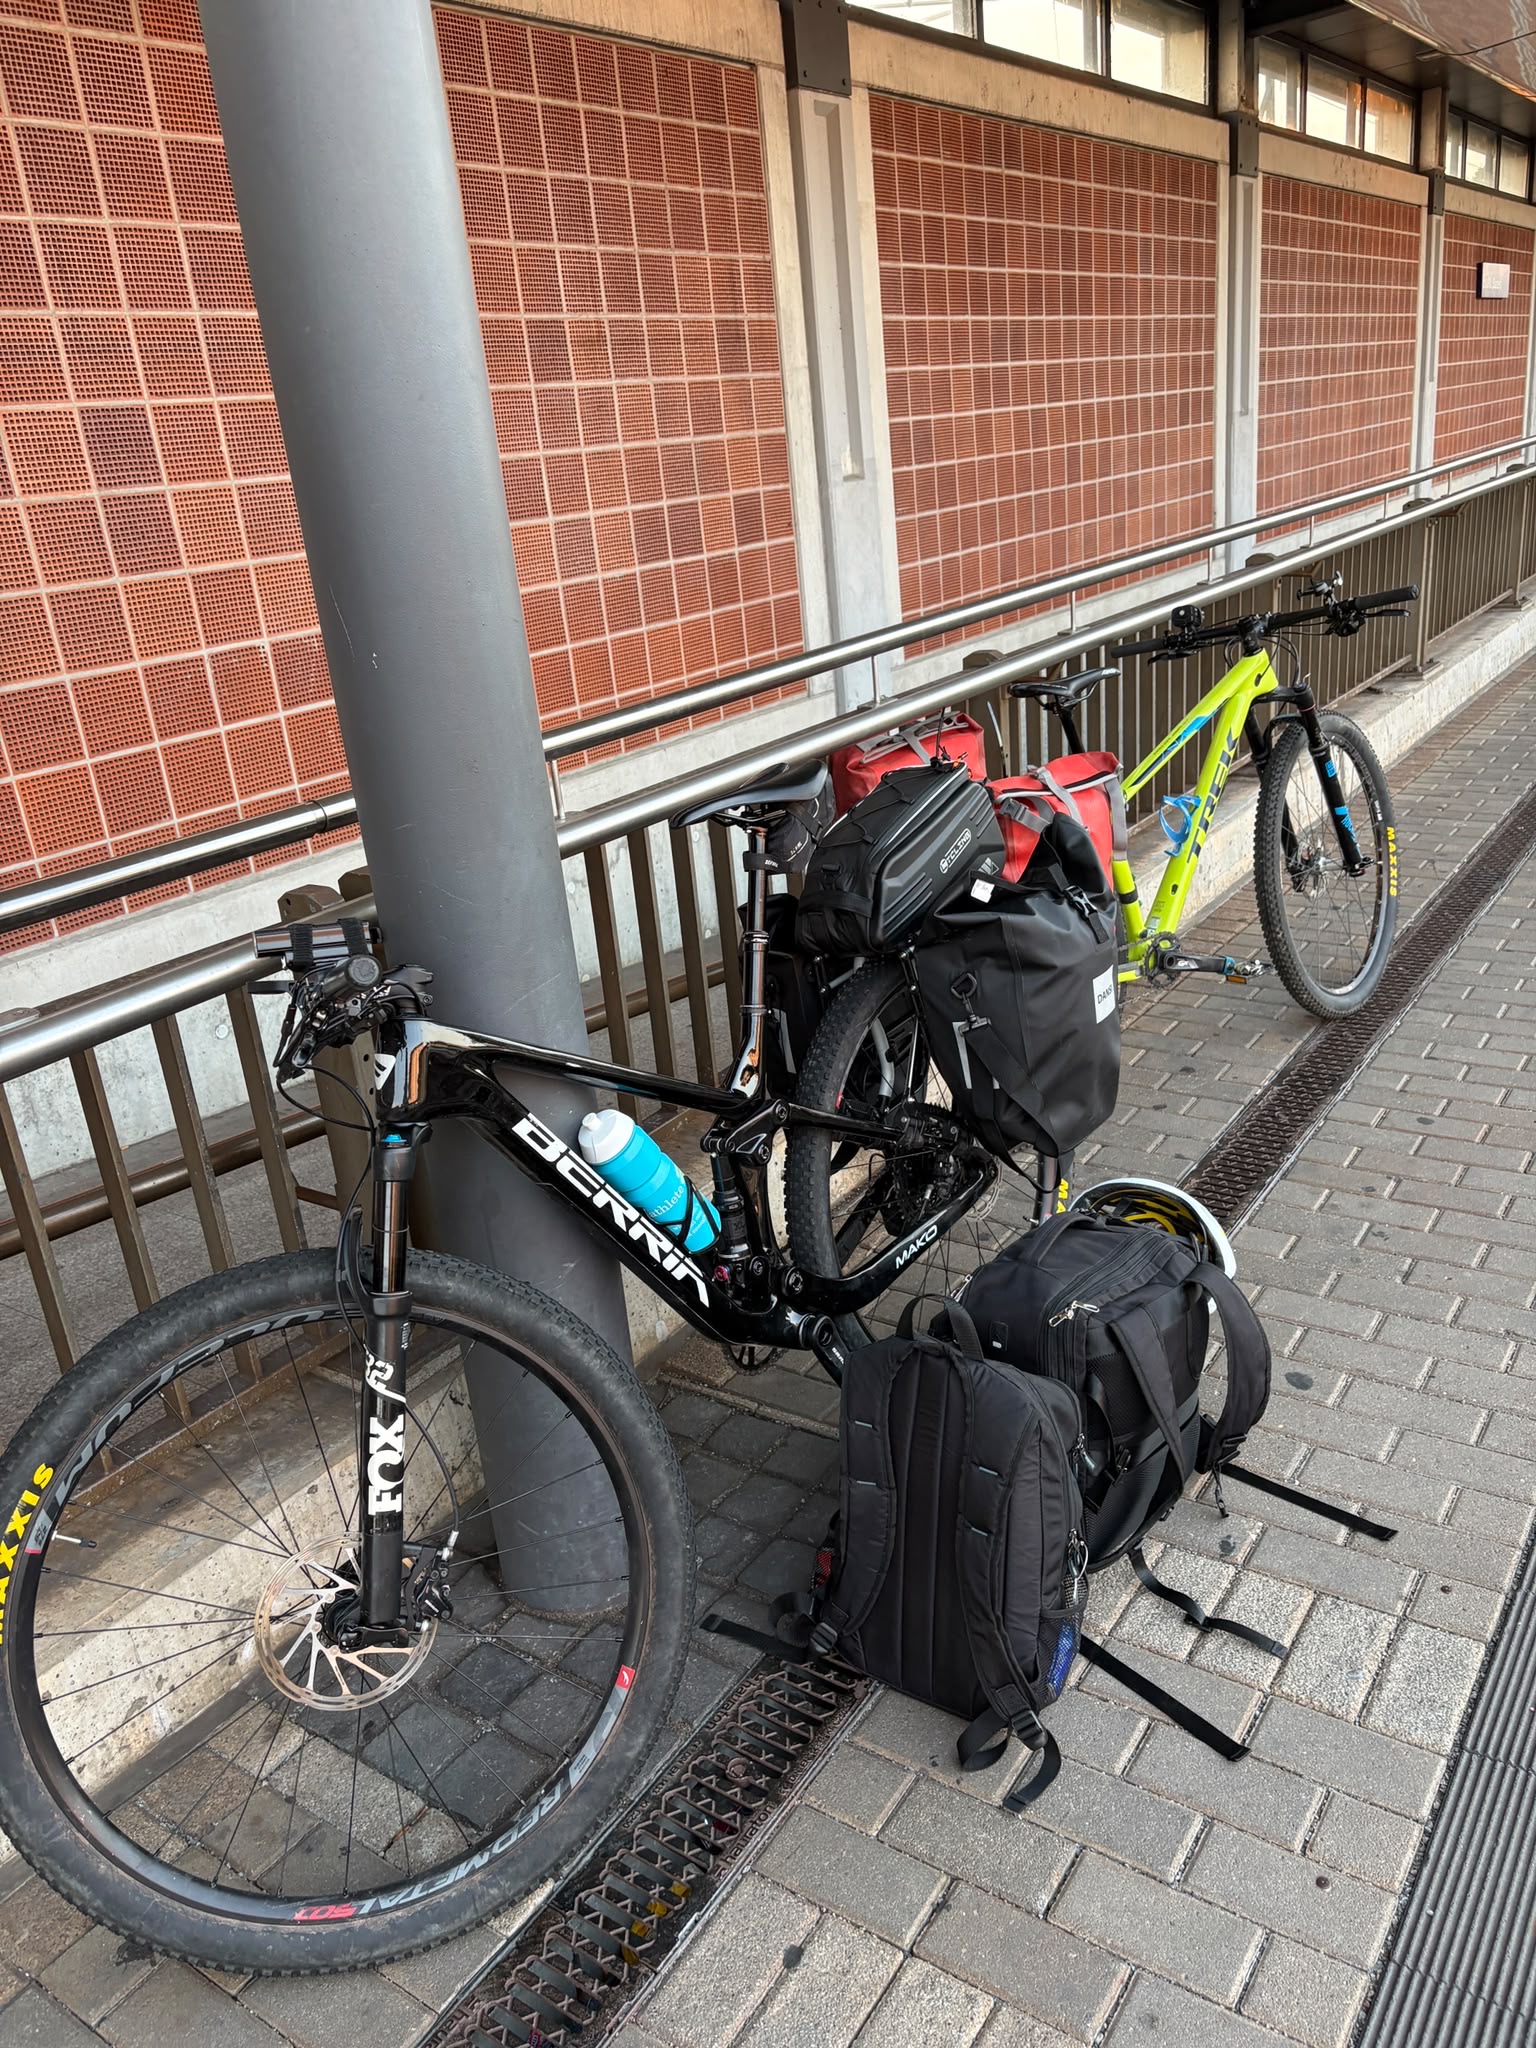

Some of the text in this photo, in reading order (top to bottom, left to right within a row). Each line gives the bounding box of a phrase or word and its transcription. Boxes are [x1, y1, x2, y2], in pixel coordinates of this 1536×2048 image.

[1186, 725, 1240, 864] TREK
[1386, 826, 1398, 897] MAXXIS
[649, 1185, 685, 1218] athlete
[895, 1225, 938, 1270] MAKO
[368, 1413, 405, 1516] FOX
[0, 1463, 54, 1645] XXIS
[706, 1676, 759, 1730] hauraton
[721, 1803, 774, 1864] hauraton
